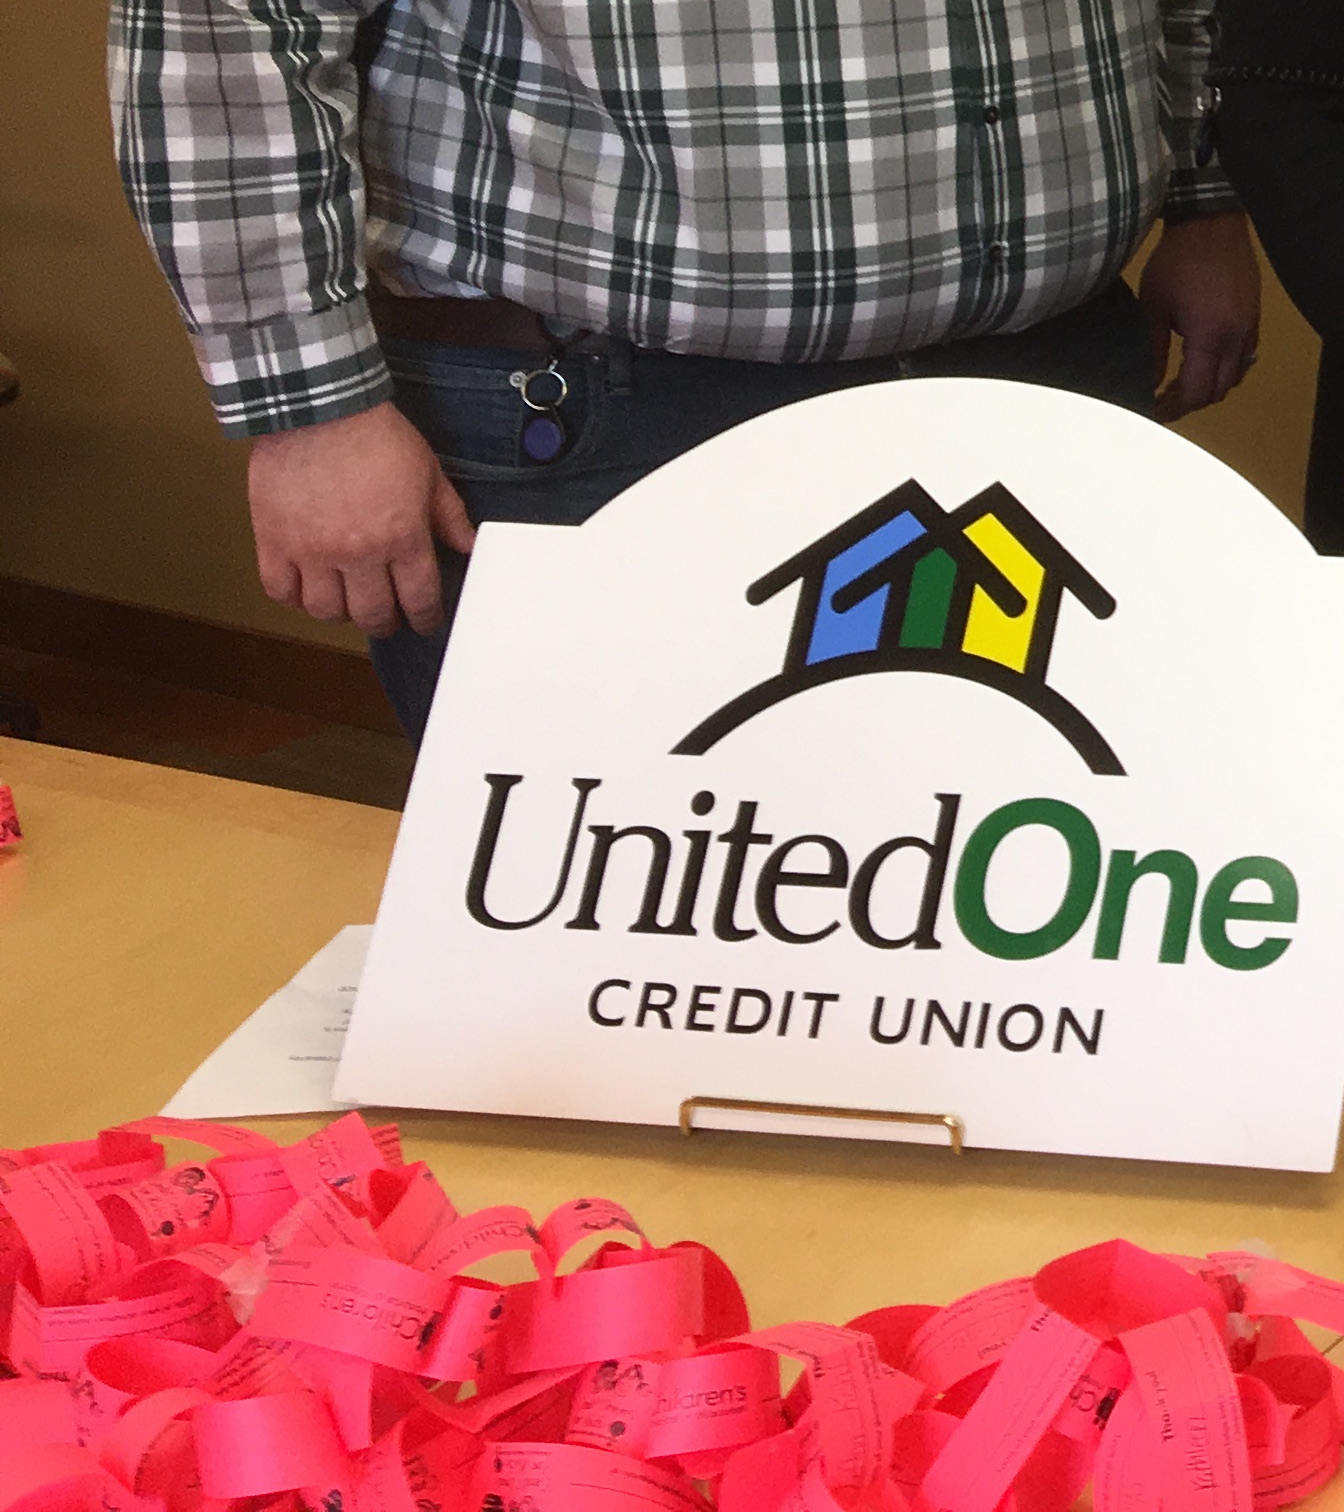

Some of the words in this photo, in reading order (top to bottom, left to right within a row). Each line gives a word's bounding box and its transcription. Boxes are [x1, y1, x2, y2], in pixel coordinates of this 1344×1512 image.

[464, 772, 1301, 972] UnitedOne
[586, 977, 840, 1040] CREDIT
[869, 994, 1106, 1057] UNION
